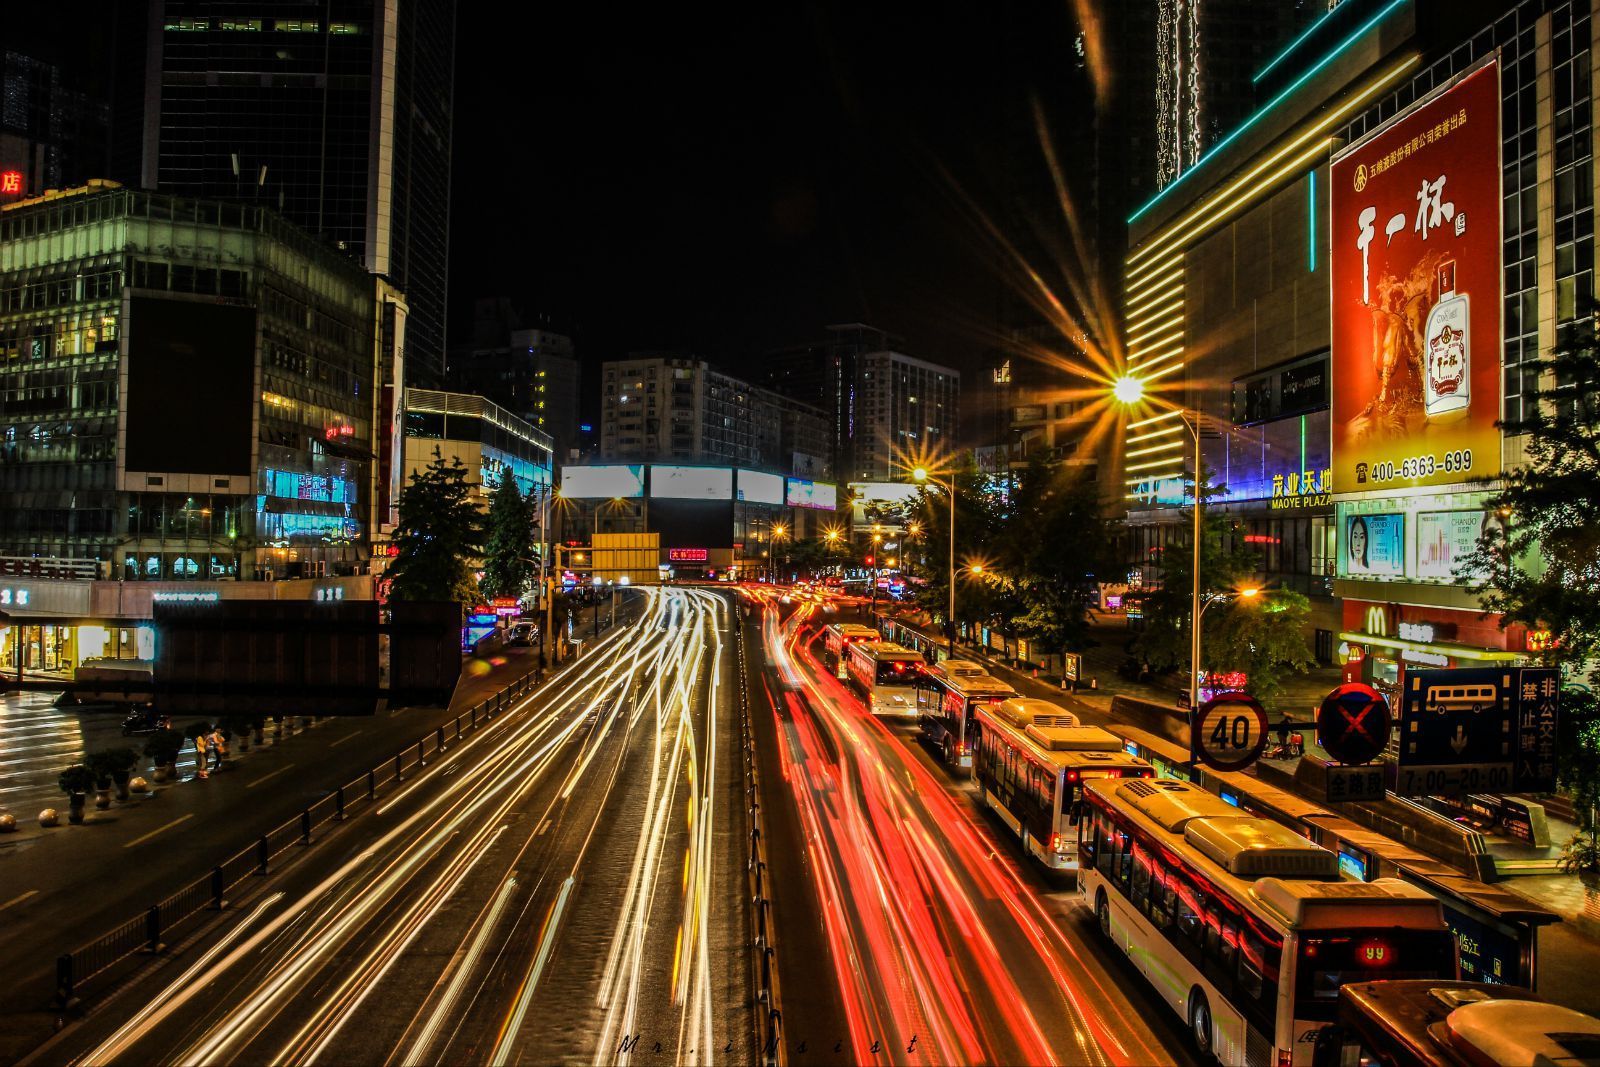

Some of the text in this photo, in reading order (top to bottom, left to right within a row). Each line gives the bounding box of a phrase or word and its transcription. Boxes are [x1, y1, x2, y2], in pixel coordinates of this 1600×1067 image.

[1370, 108, 1467, 179] 五粮液股份有限公司荣誉出品
[2, 173, 20, 192] 店
[1371, 450, 1472, 482] 400-6363-699
[1273, 468, 1332, 498] 茂业天地
[1272, 494, 1332, 509] MAOYE PLAZA
[1451, 517, 1477, 526] CHANDO
[1210, 715, 1250, 750] 40
[1520, 682, 1538, 779] 禁止驶入
[1537, 677, 1556, 780] 非公交车辆
[1366, 947, 1384, 960] 99
